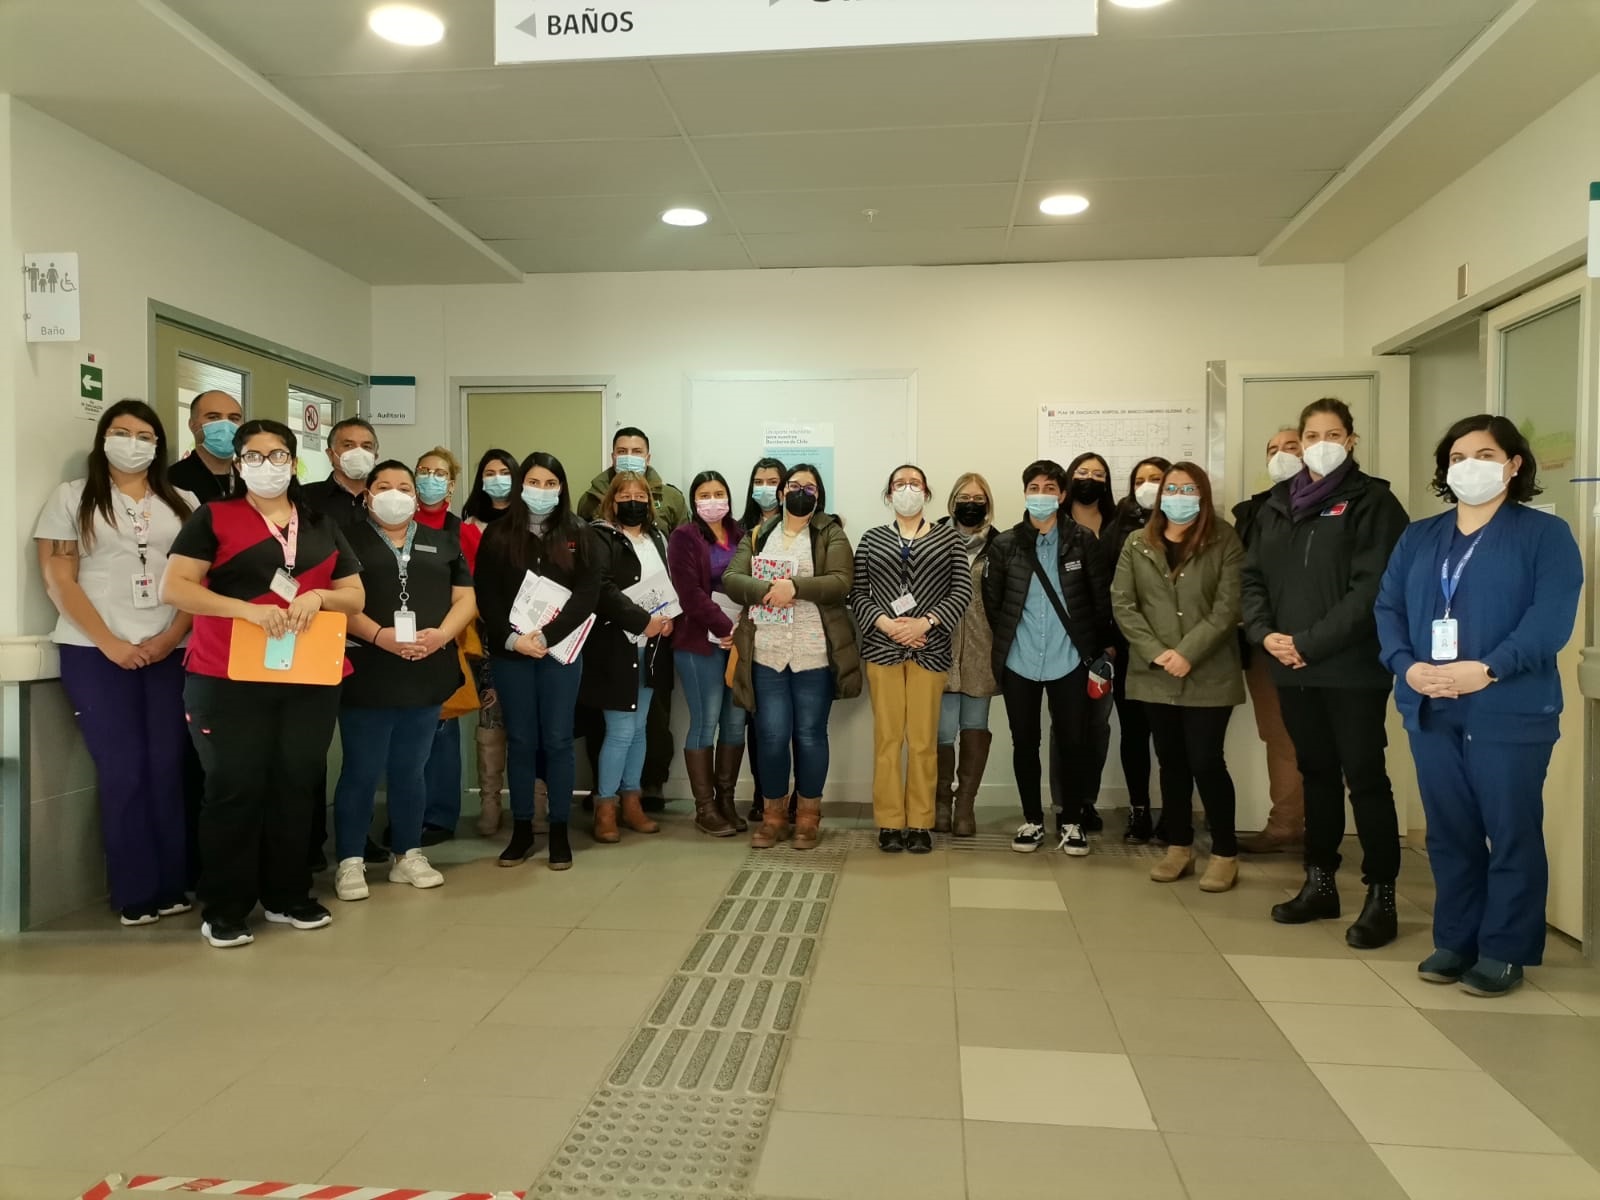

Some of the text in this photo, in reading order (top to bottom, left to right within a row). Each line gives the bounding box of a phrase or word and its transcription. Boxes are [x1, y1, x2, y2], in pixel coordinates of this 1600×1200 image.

[547, 7, 634, 36] BAÑOS
[40, 325, 65, 336] Baño
[377, 411, 406, 419] Auditorio
